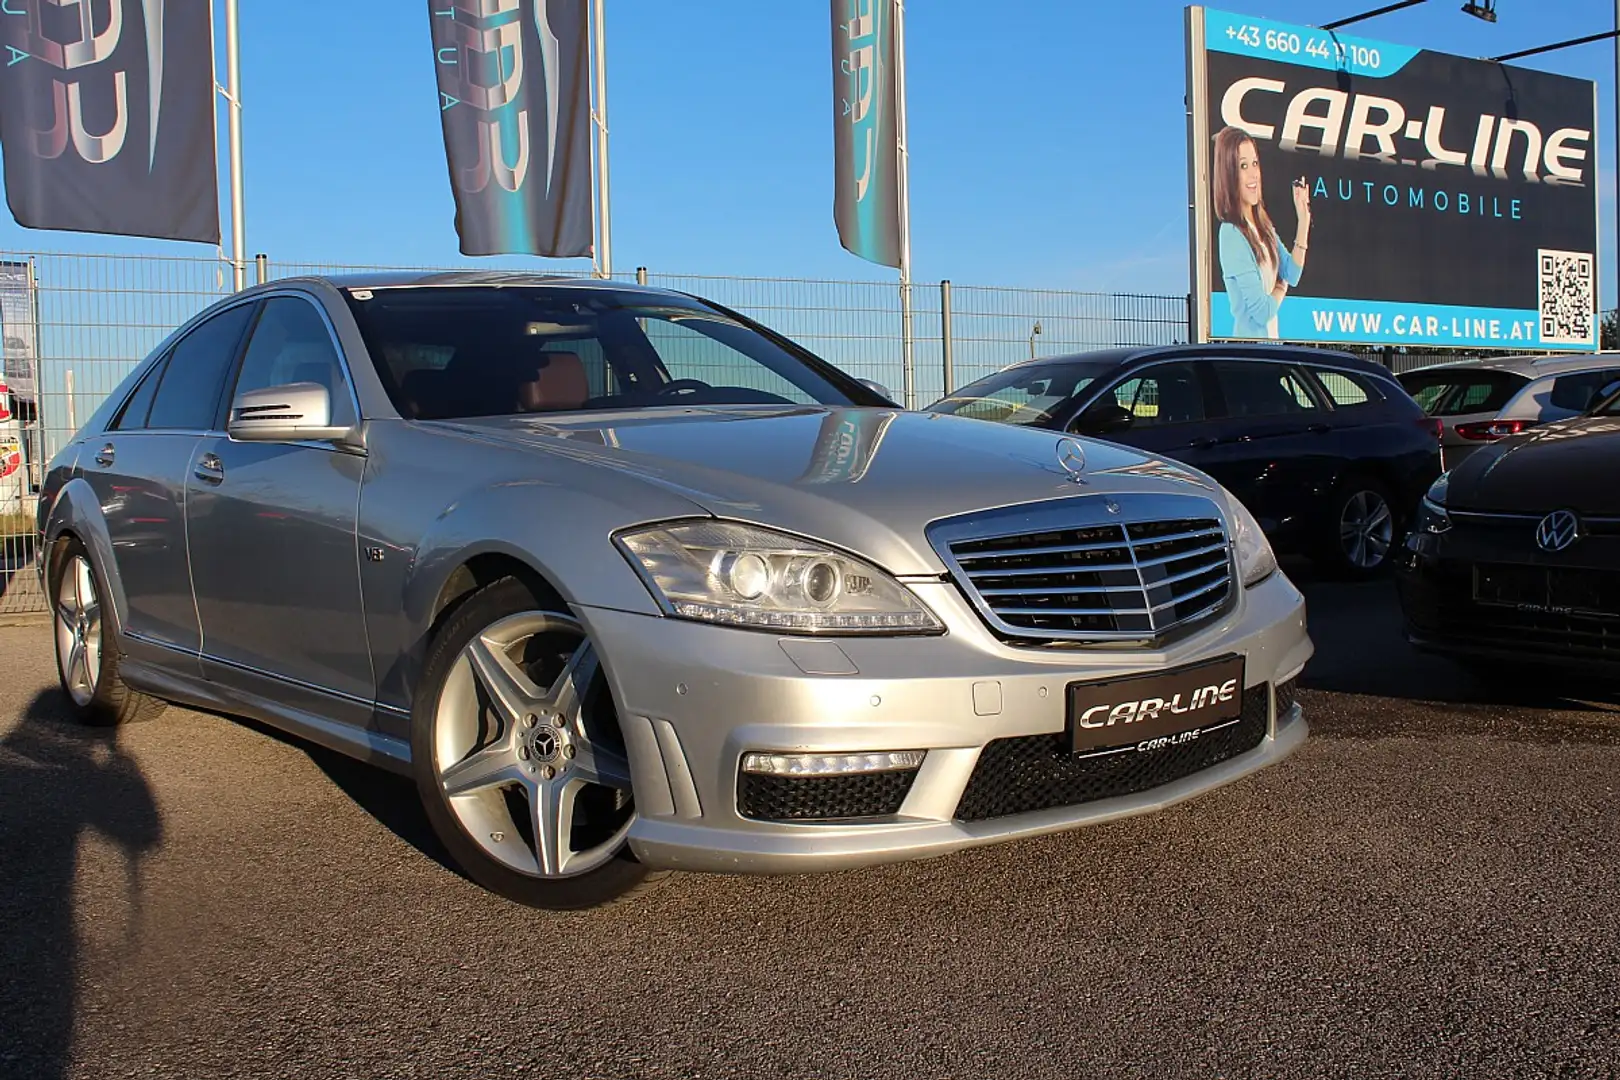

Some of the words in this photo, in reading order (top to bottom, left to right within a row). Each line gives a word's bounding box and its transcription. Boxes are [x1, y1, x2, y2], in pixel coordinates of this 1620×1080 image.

[1226, 24, 1260, 47] +43
[1265, 29, 1300, 54] 660
[1305, 38, 1330, 59] 44
[1351, 45, 1381, 69] 100
[1221, 77, 1591, 179] CAR-LINE
[1313, 176, 1522, 219] AUTOMOBILE
[1311, 310, 1535, 341] WWW.CAR-LINE.AT
[1079, 678, 1237, 729] CAR-LINE
[1137, 728, 1200, 752] CAR-LINE
